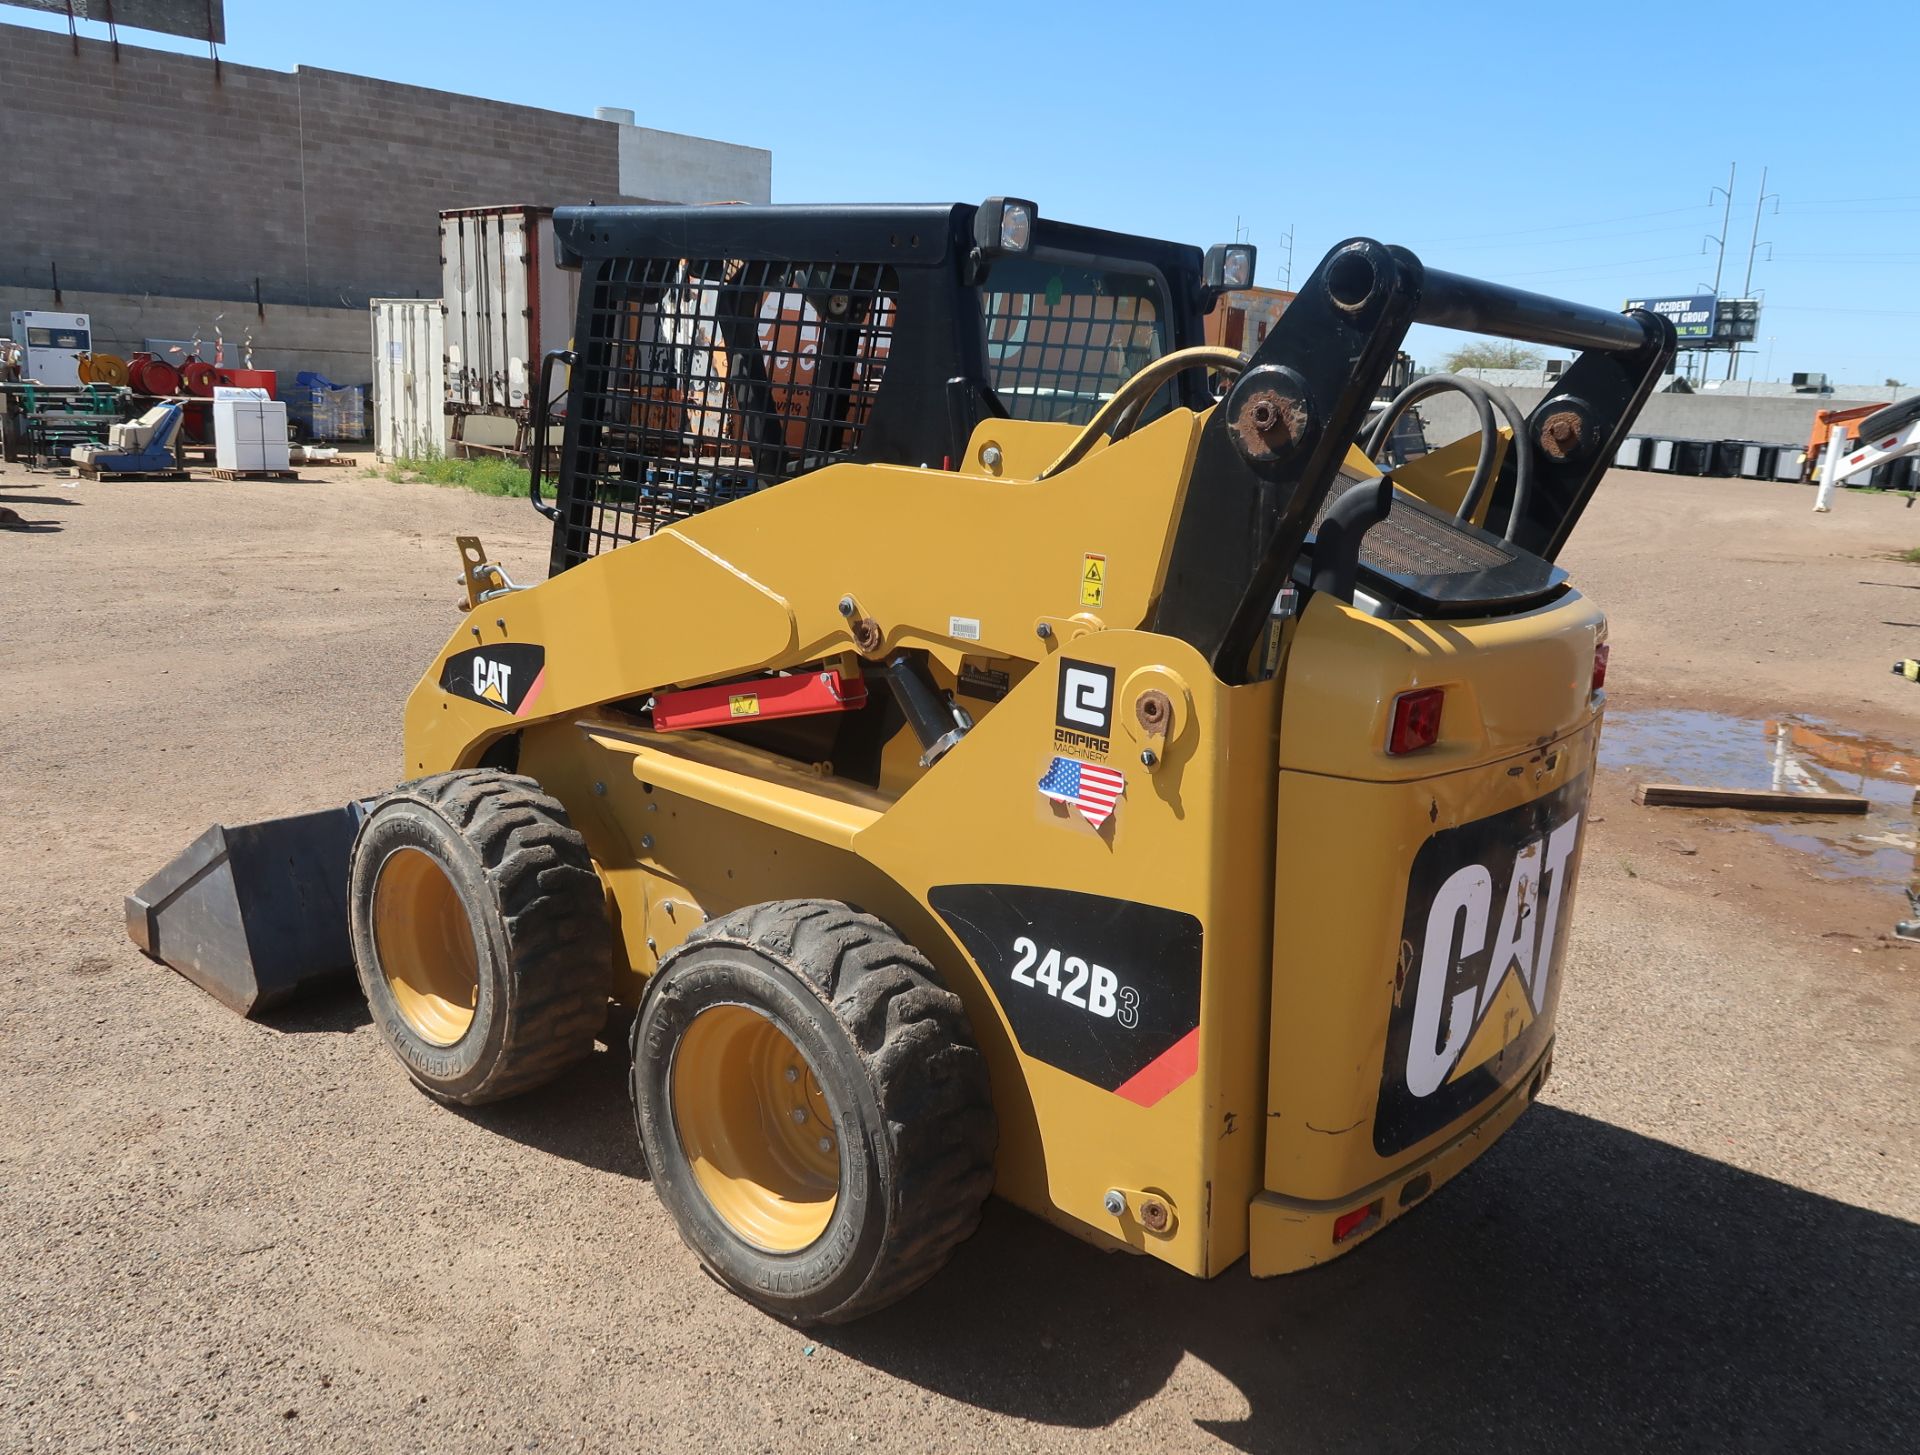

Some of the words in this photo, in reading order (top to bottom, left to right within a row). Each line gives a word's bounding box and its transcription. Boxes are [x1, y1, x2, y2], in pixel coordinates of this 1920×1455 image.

[1653, 300, 1691, 312] ACCIDENT
[1681, 311, 1710, 323] GROUP
[473, 656, 511, 705] CAT
[1054, 742, 1108, 762] MACHINERY
[1406, 813, 1579, 1097] CAT
